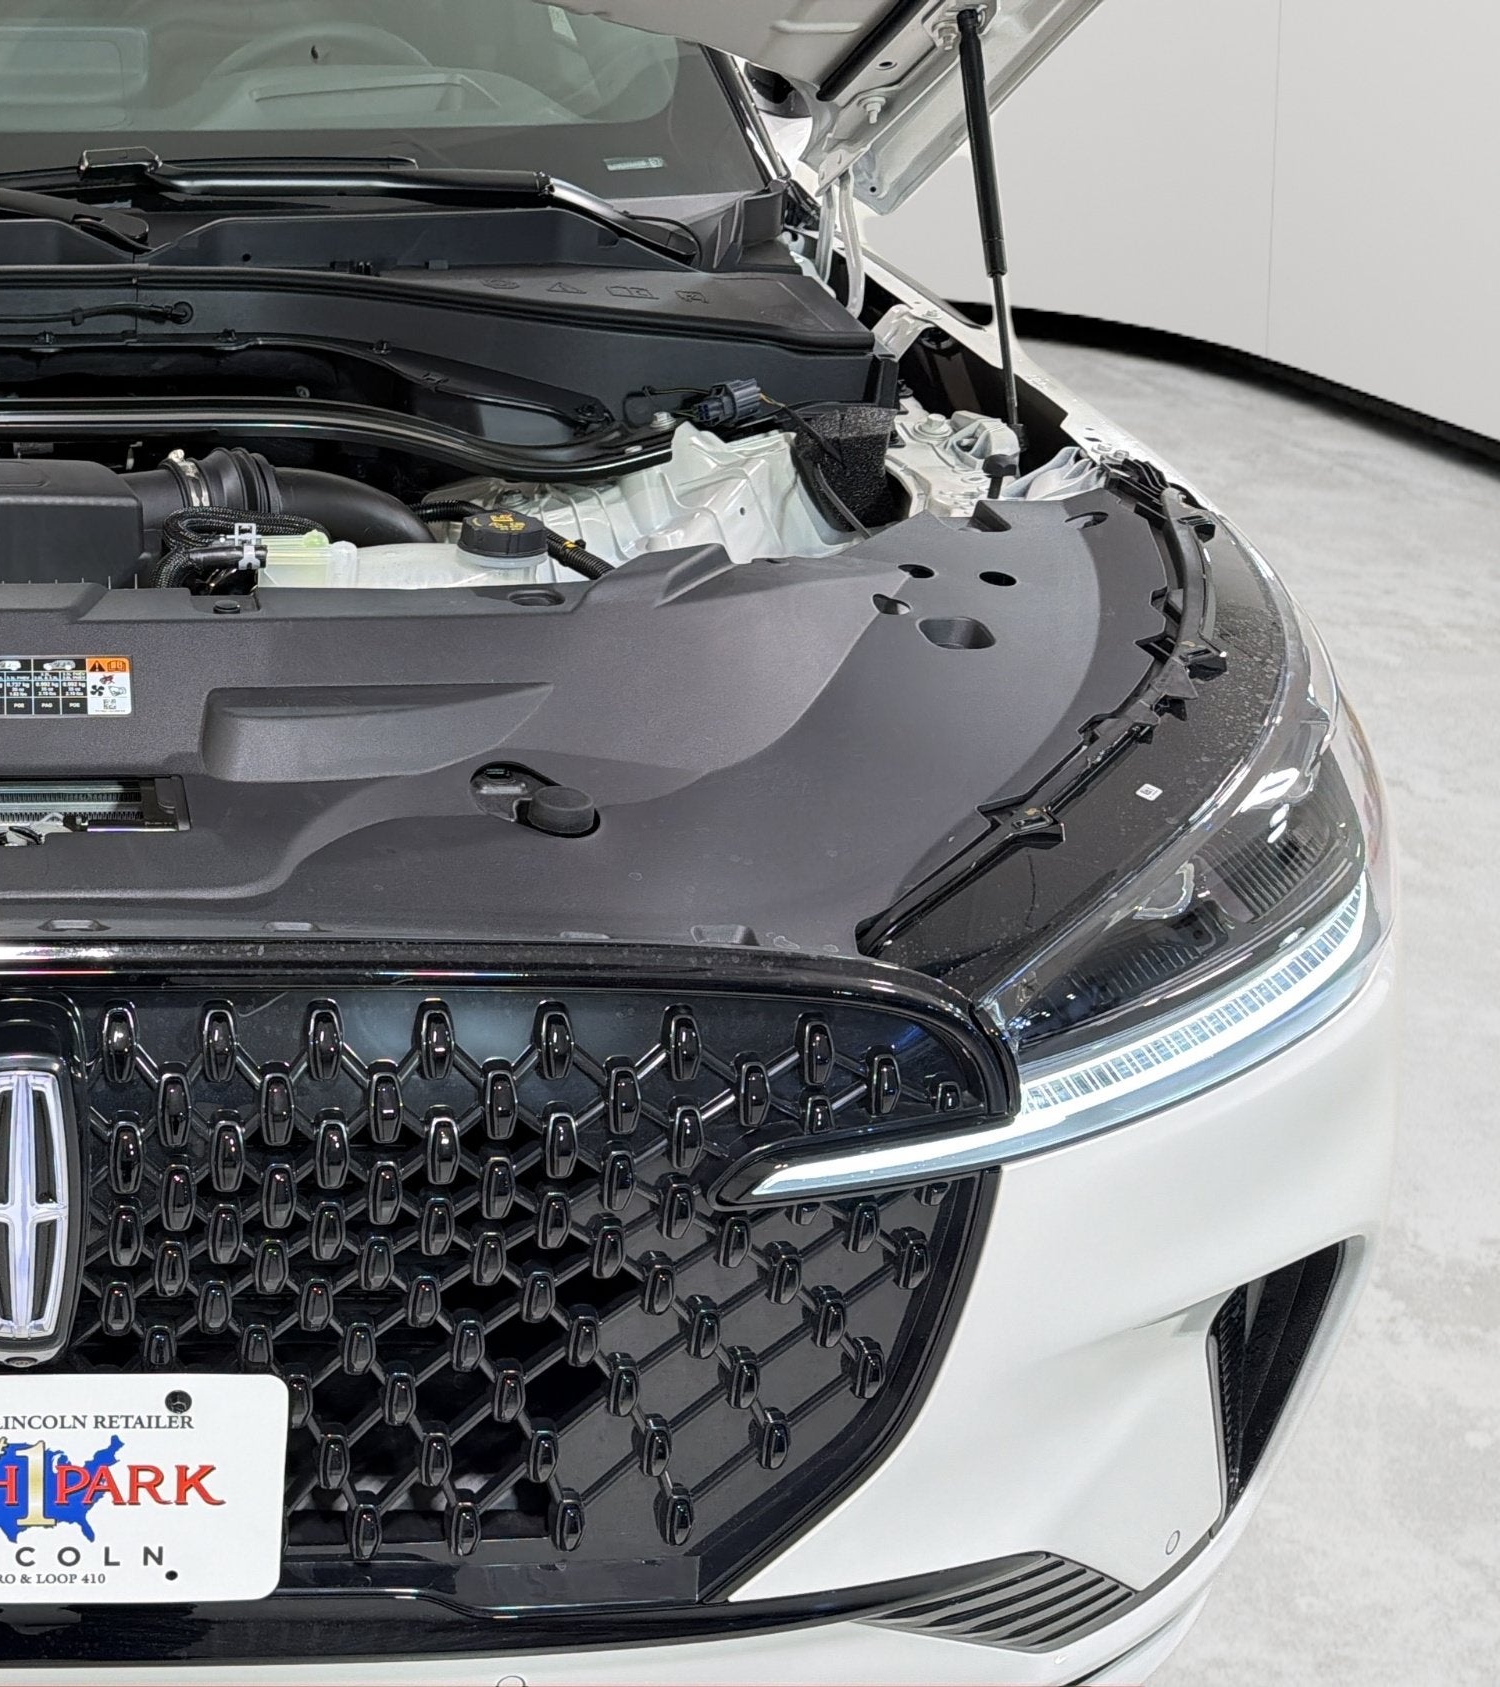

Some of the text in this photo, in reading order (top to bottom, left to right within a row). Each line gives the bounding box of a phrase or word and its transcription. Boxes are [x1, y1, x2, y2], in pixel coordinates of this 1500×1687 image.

[92, 1413, 195, 1430] RETAILER
[55, 1463, 227, 1507] PARK
[20, 1573, 32, 1585] &
[35, 1573, 78, 1585] LOOP
[81, 1573, 107, 1585] 410
